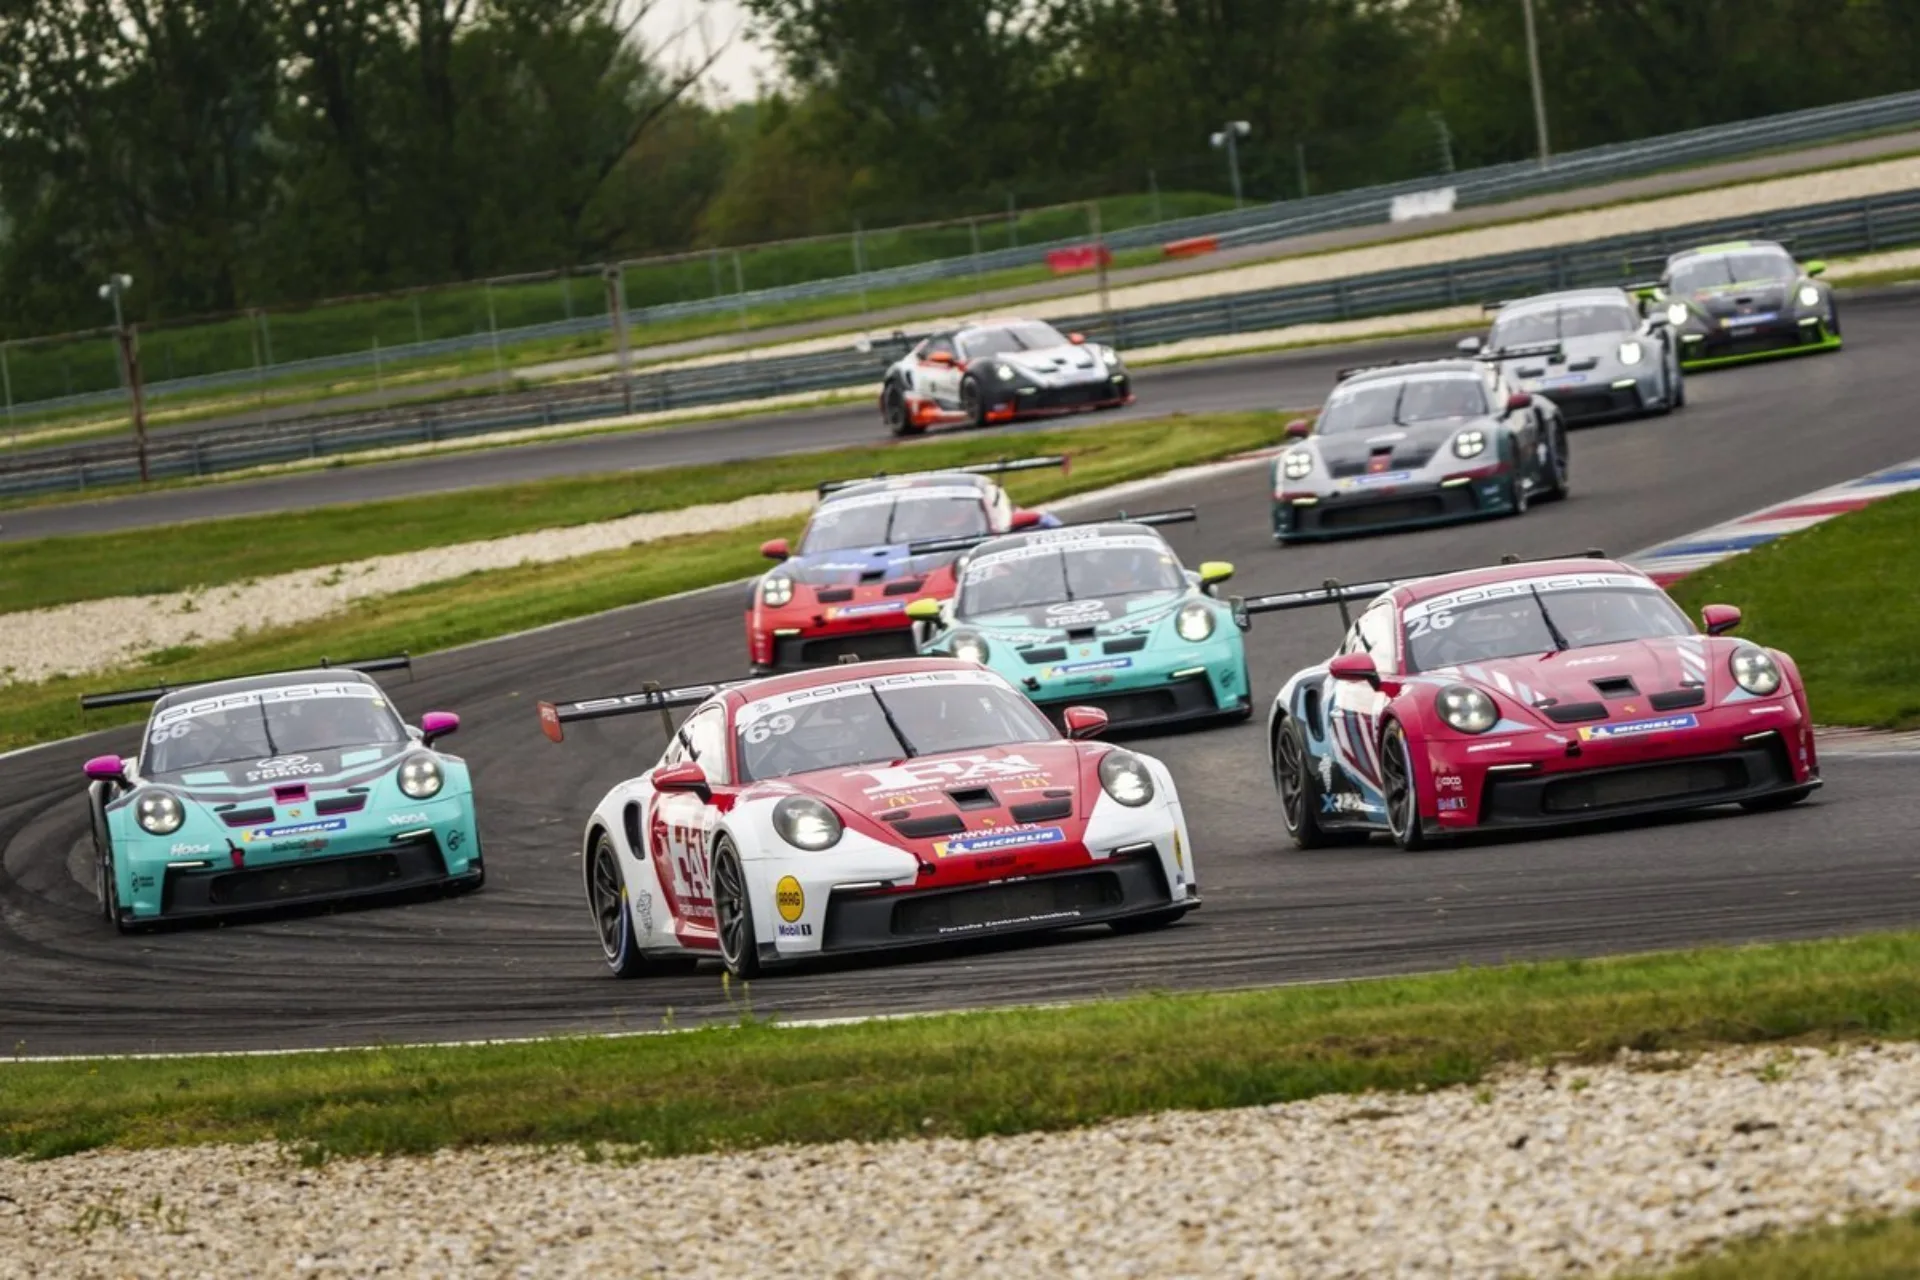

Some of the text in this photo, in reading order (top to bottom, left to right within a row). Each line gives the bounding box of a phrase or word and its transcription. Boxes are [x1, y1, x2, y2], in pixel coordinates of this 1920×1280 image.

[1426, 578, 1636, 611] PORSCHE
[1407, 611, 1454, 640] 26
[788, 674, 957, 702] PORSCHE
[161, 686, 373, 722] PORSCHE
[150, 720, 191, 745] 66
[745, 714, 796, 744] 69
[1613, 717, 1688, 733] MICHELIN
[945, 771, 1053, 787] AUTOMOTIVE
[271, 821, 341, 836] MICHELIN
[972, 831, 1054, 849] MICHELIN
[779, 924, 801, 936] Mobil
[939, 923, 983, 933] Porsche
[985, 916, 1030, 927] Zentrum
